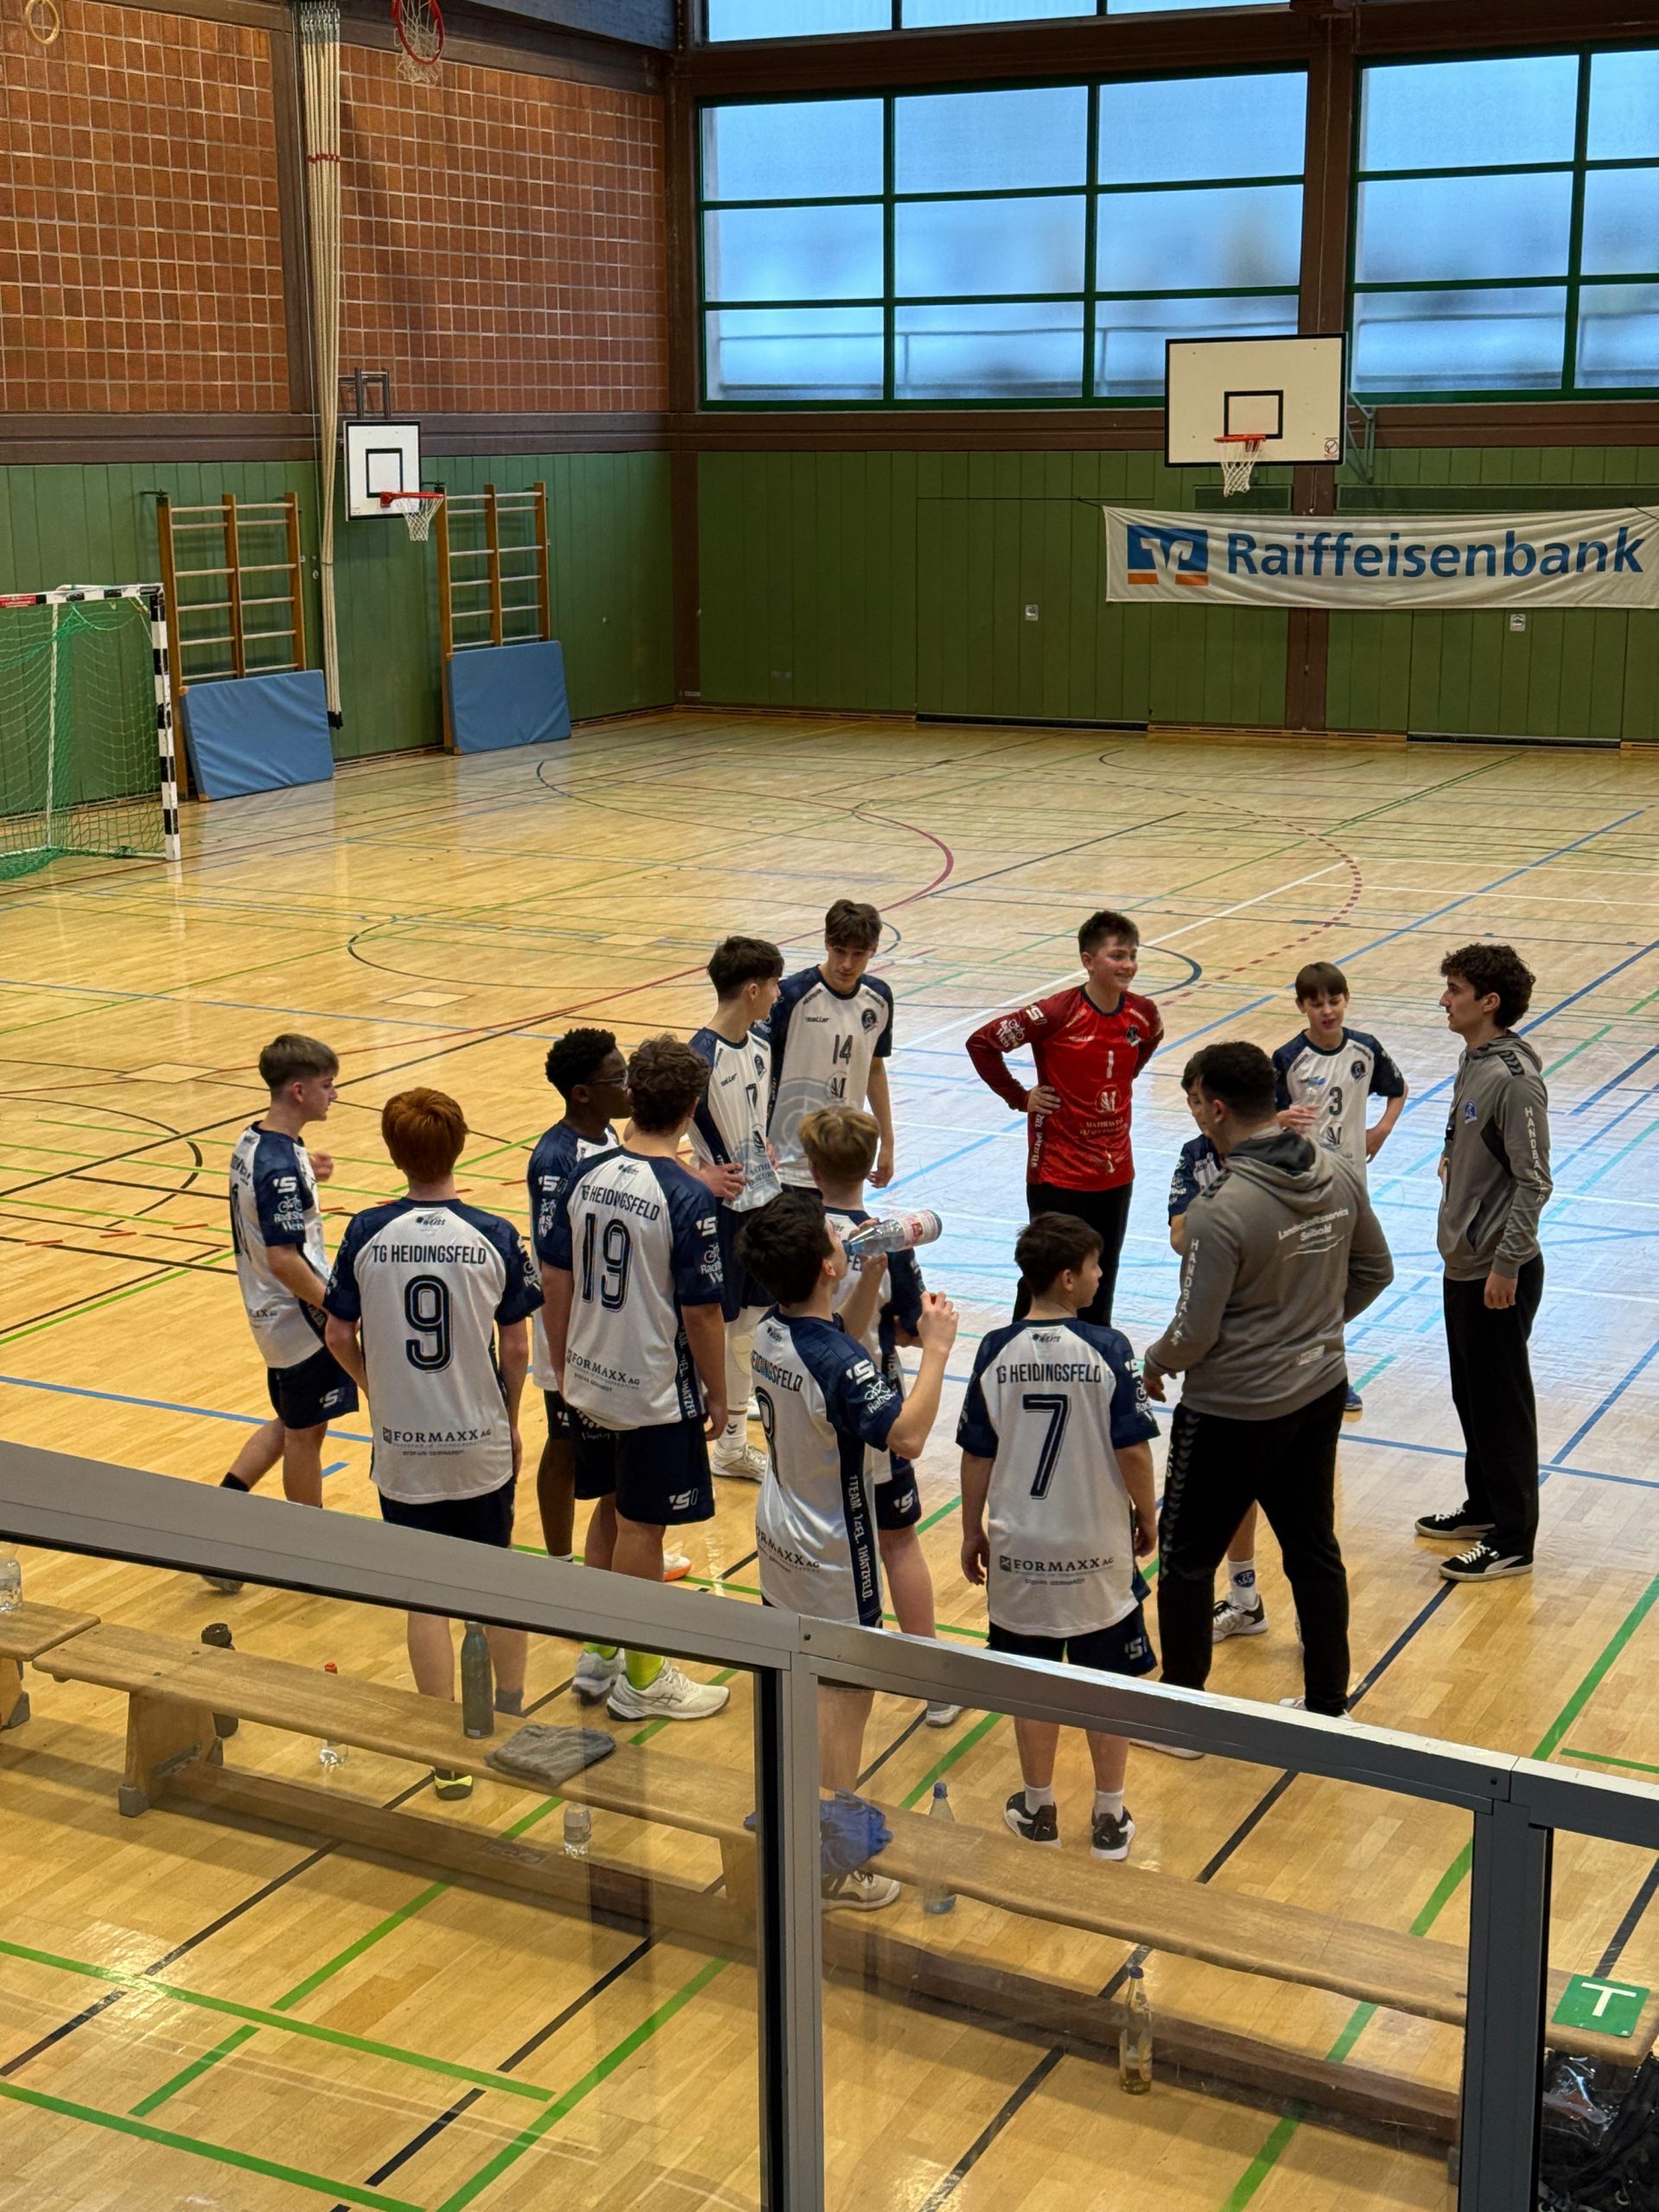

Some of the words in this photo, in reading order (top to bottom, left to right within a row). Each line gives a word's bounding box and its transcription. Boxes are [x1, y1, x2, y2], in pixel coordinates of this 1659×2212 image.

[1227, 526, 1645, 579] Raiffeisenbank
[832, 1033, 854, 1065] 14
[1106, 1050, 1115, 1079] 1
[1329, 1086, 1343, 1116] 3
[372, 1244, 387, 1263] TG
[391, 1245, 486, 1265] HEIDINGSFELD
[582, 1211, 633, 1313] 19
[404, 1274, 454, 1374] 9
[571, 1353, 627, 1383] FORMAXX
[628, 1377, 640, 1386] AG
[751, 1350, 804, 1392] EIDINGSFELD
[1010, 1363, 1102, 1384] HEIDINGSFELD
[393, 1428, 479, 1443] FORMAXX
[480, 1428, 492, 1439] AG
[1022, 1394, 1071, 1500] 7
[756, 1526, 804, 1567] ORMAXX
[1014, 1557, 1100, 1573] FORMAXX
[1580, 1981, 1637, 2018] T
